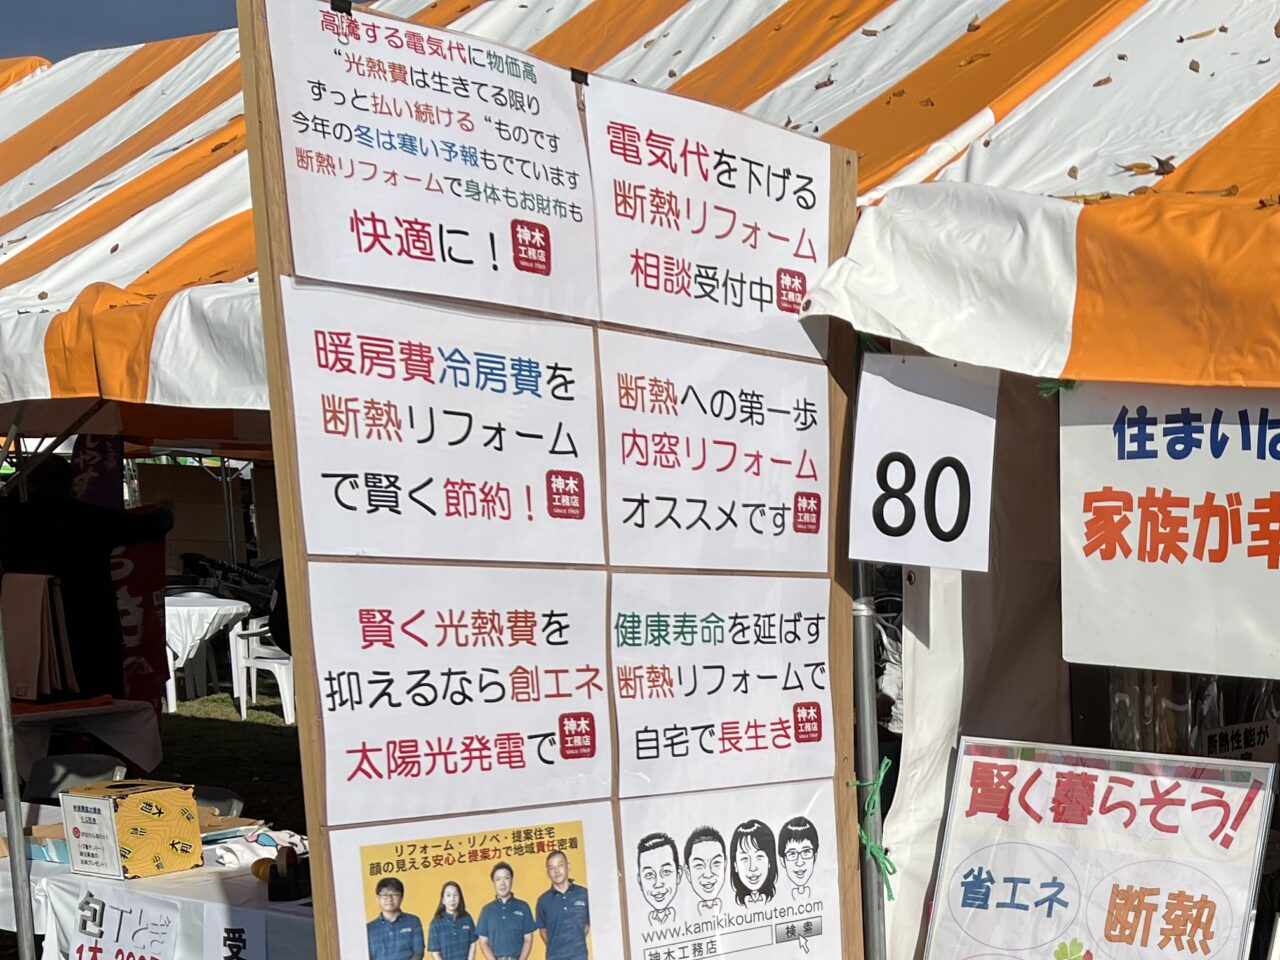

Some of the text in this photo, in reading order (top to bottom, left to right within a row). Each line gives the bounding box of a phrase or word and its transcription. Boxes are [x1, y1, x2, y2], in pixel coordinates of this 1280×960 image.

[291, 110, 581, 190] 今年の冬は寒い予報もでています
[606, 120, 818, 211] 電気代を下げる
[295, 147, 584, 224] 断熱リフォームで身体もお財布も
[516, 224, 545, 247] 神木
[613, 178, 817, 263] 断熱リフォーム
[630, 249, 773, 312] 相談受付中
[780, 271, 802, 291] 神木
[314, 329, 576, 402] 暖房費冷房費を
[321, 393, 580, 459] 断熱リフォーム
[617, 373, 819, 432] 断熱への第一歩
[621, 428, 819, 483] 内窓リフォーム
[550, 475, 579, 495] 神木
[796, 495, 818, 512] 神木
[871, 451, 971, 543] 80
[622, 495, 793, 537] オススメです
[358, 608, 571, 650] 賢く光熱費を
[614, 611, 827, 649] 健康寿命を延ばす
[324, 665, 604, 712] 抑えるなら創エネ
[617, 661, 827, 700] 断熱リフォームで
[563, 716, 590, 735] 神木
[635, 717, 794, 761] 自宅で長生き
[796, 706, 818, 723] 神木
[346, 730, 557, 783] 太陽光発電で
[960, 865, 1070, 919] 省エネ
[642, 899, 824, 944] www.kamikikoumuten.com
[1103, 883, 1219, 957] 断熱
